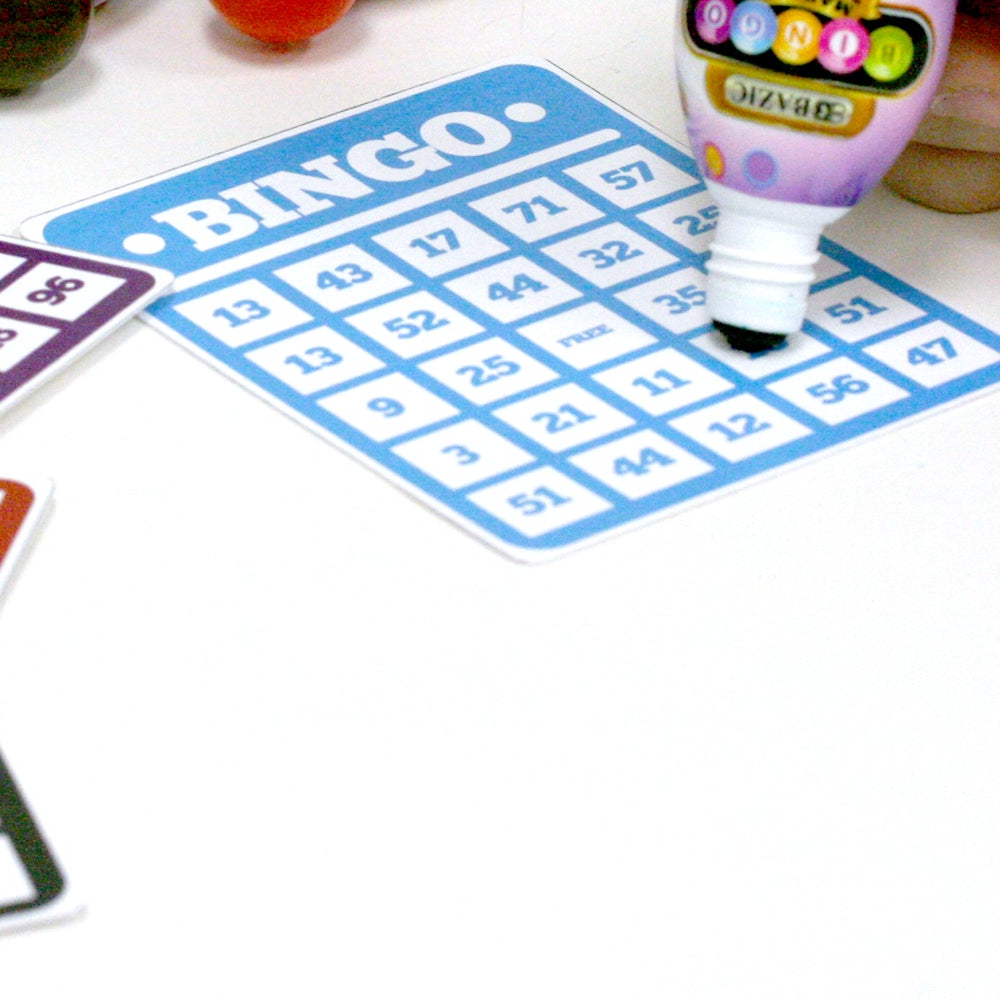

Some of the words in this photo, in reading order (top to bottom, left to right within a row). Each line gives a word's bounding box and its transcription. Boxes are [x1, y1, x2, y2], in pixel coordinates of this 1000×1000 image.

[731, 82, 808, 110] BAZIC
[151, 111, 513, 252] BINGO
[213, 299, 271, 328] 13
[317, 263, 373, 290] 43
[409, 227, 461, 258] 17
[501, 195, 568, 224] 71
[599, 160, 655, 191] 57
[27, 276, 84, 305] 96
[285, 347, 343, 375] 13
[383, 310, 450, 339] 52
[488, 273, 549, 302] 44
[578, 240, 645, 270] 32
[367, 397, 405, 418] 9
[457, 355, 521, 387] 25
[558, 323, 614, 348] FREE
[652, 284, 708, 315] 35
[442, 445, 480, 465] 3
[532, 404, 595, 434] 21
[633, 369, 690, 396] 11
[824, 296, 889, 325] 51
[508, 487, 571, 515] 51
[614, 447, 675, 476] 44
[708, 414, 771, 442] 12
[806, 374, 870, 404] 56
[908, 336, 958, 366] 47
